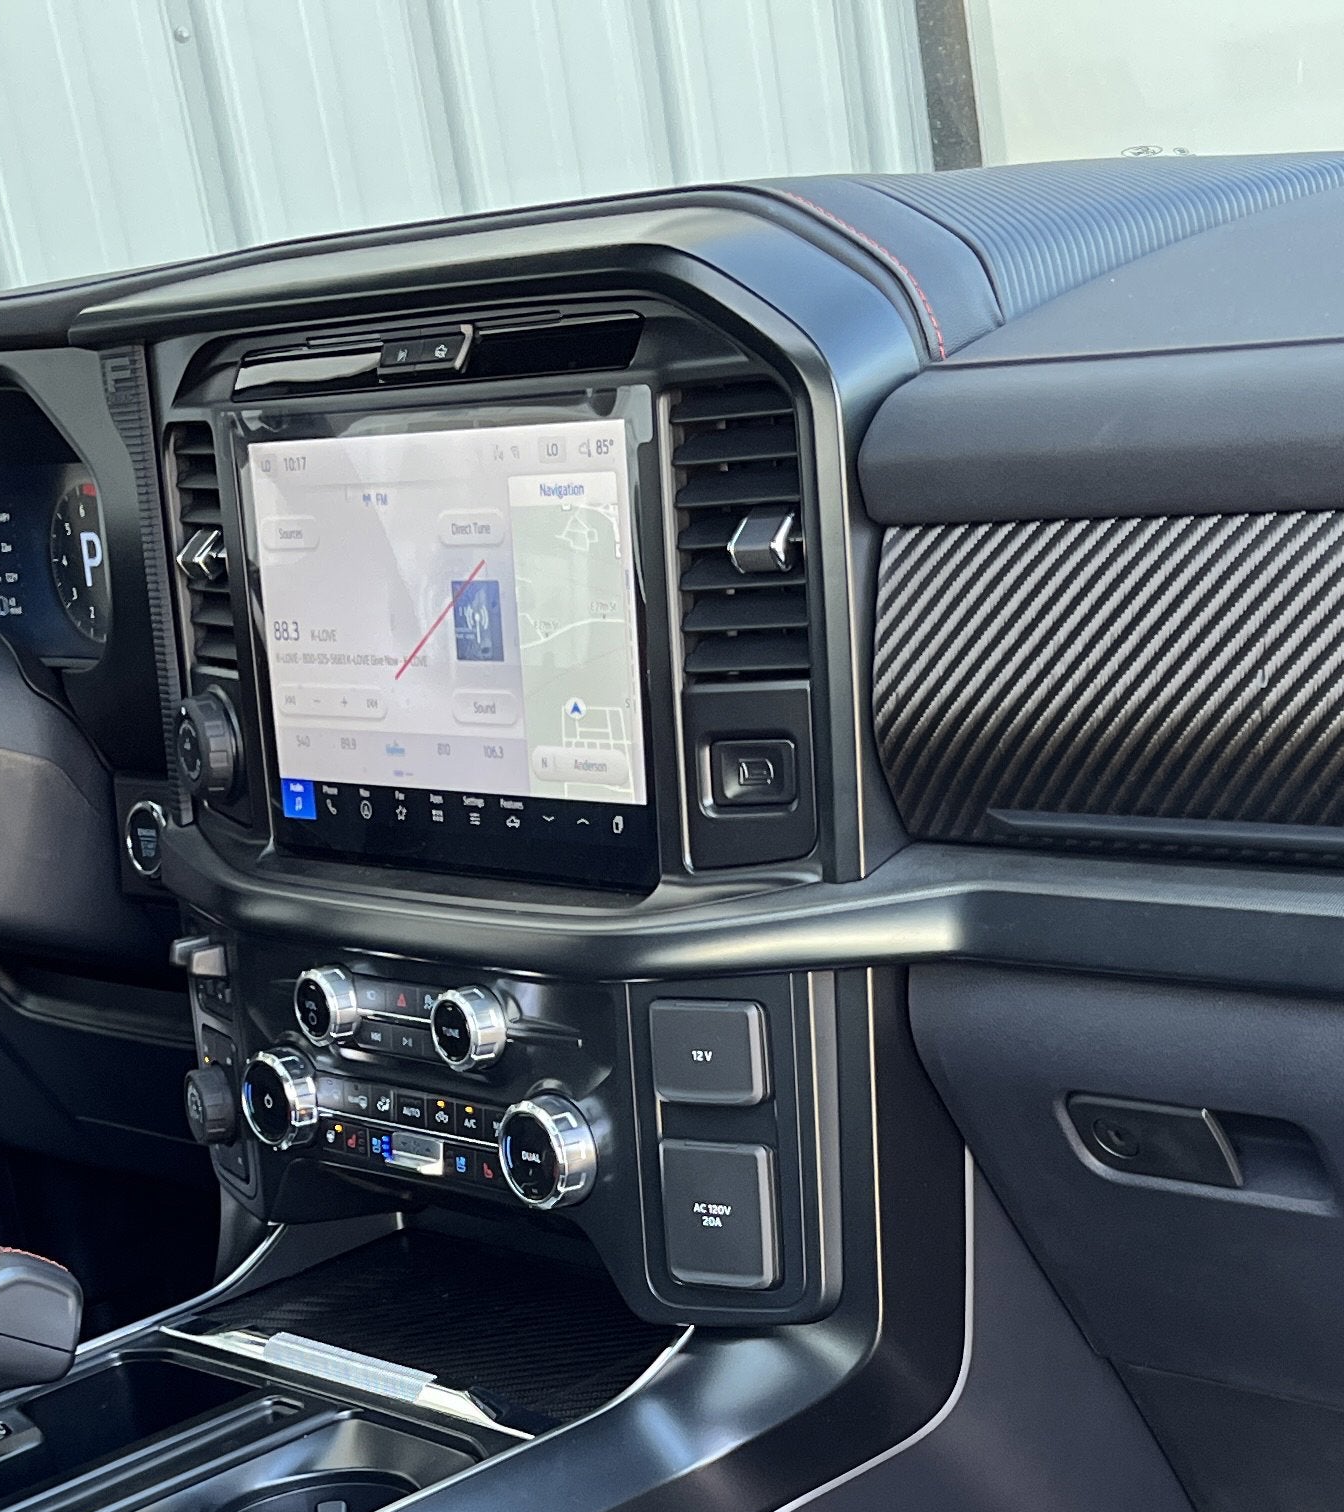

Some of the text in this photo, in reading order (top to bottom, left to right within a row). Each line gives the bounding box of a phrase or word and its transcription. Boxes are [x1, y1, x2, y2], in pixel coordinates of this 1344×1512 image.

[547, 443, 558, 457] LO
[596, 438, 614, 455] 85°
[283, 457, 306, 472] 10:17
[539, 484, 585, 499] Navigation
[376, 493, 388, 506] FM
[79, 505, 85, 517] 6
[65, 522, 72, 536] 5
[278, 528, 303, 540] Sources
[451, 522, 491, 535] Direct Tune
[62, 555, 68, 567] 4
[80, 531, 103, 587] P
[72, 587, 78, 601] 3
[273, 621, 300, 642] 88.3
[310, 629, 337, 643] K-LOVE
[473, 701, 496, 715] Sound
[296, 735, 311, 748] 540
[438, 743, 451, 757] 810
[483, 745, 505, 759] 106.3
[574, 759, 608, 773] Anderson
[691, 1050, 704, 1062] 12
[402, 1106, 421, 1119] AUTO
[463, 1118, 477, 1130] A/C
[521, 1150, 542, 1164] DUAL
[693, 1202, 732, 1217] AC 120V
[701, 1216, 723, 1228] 20A
